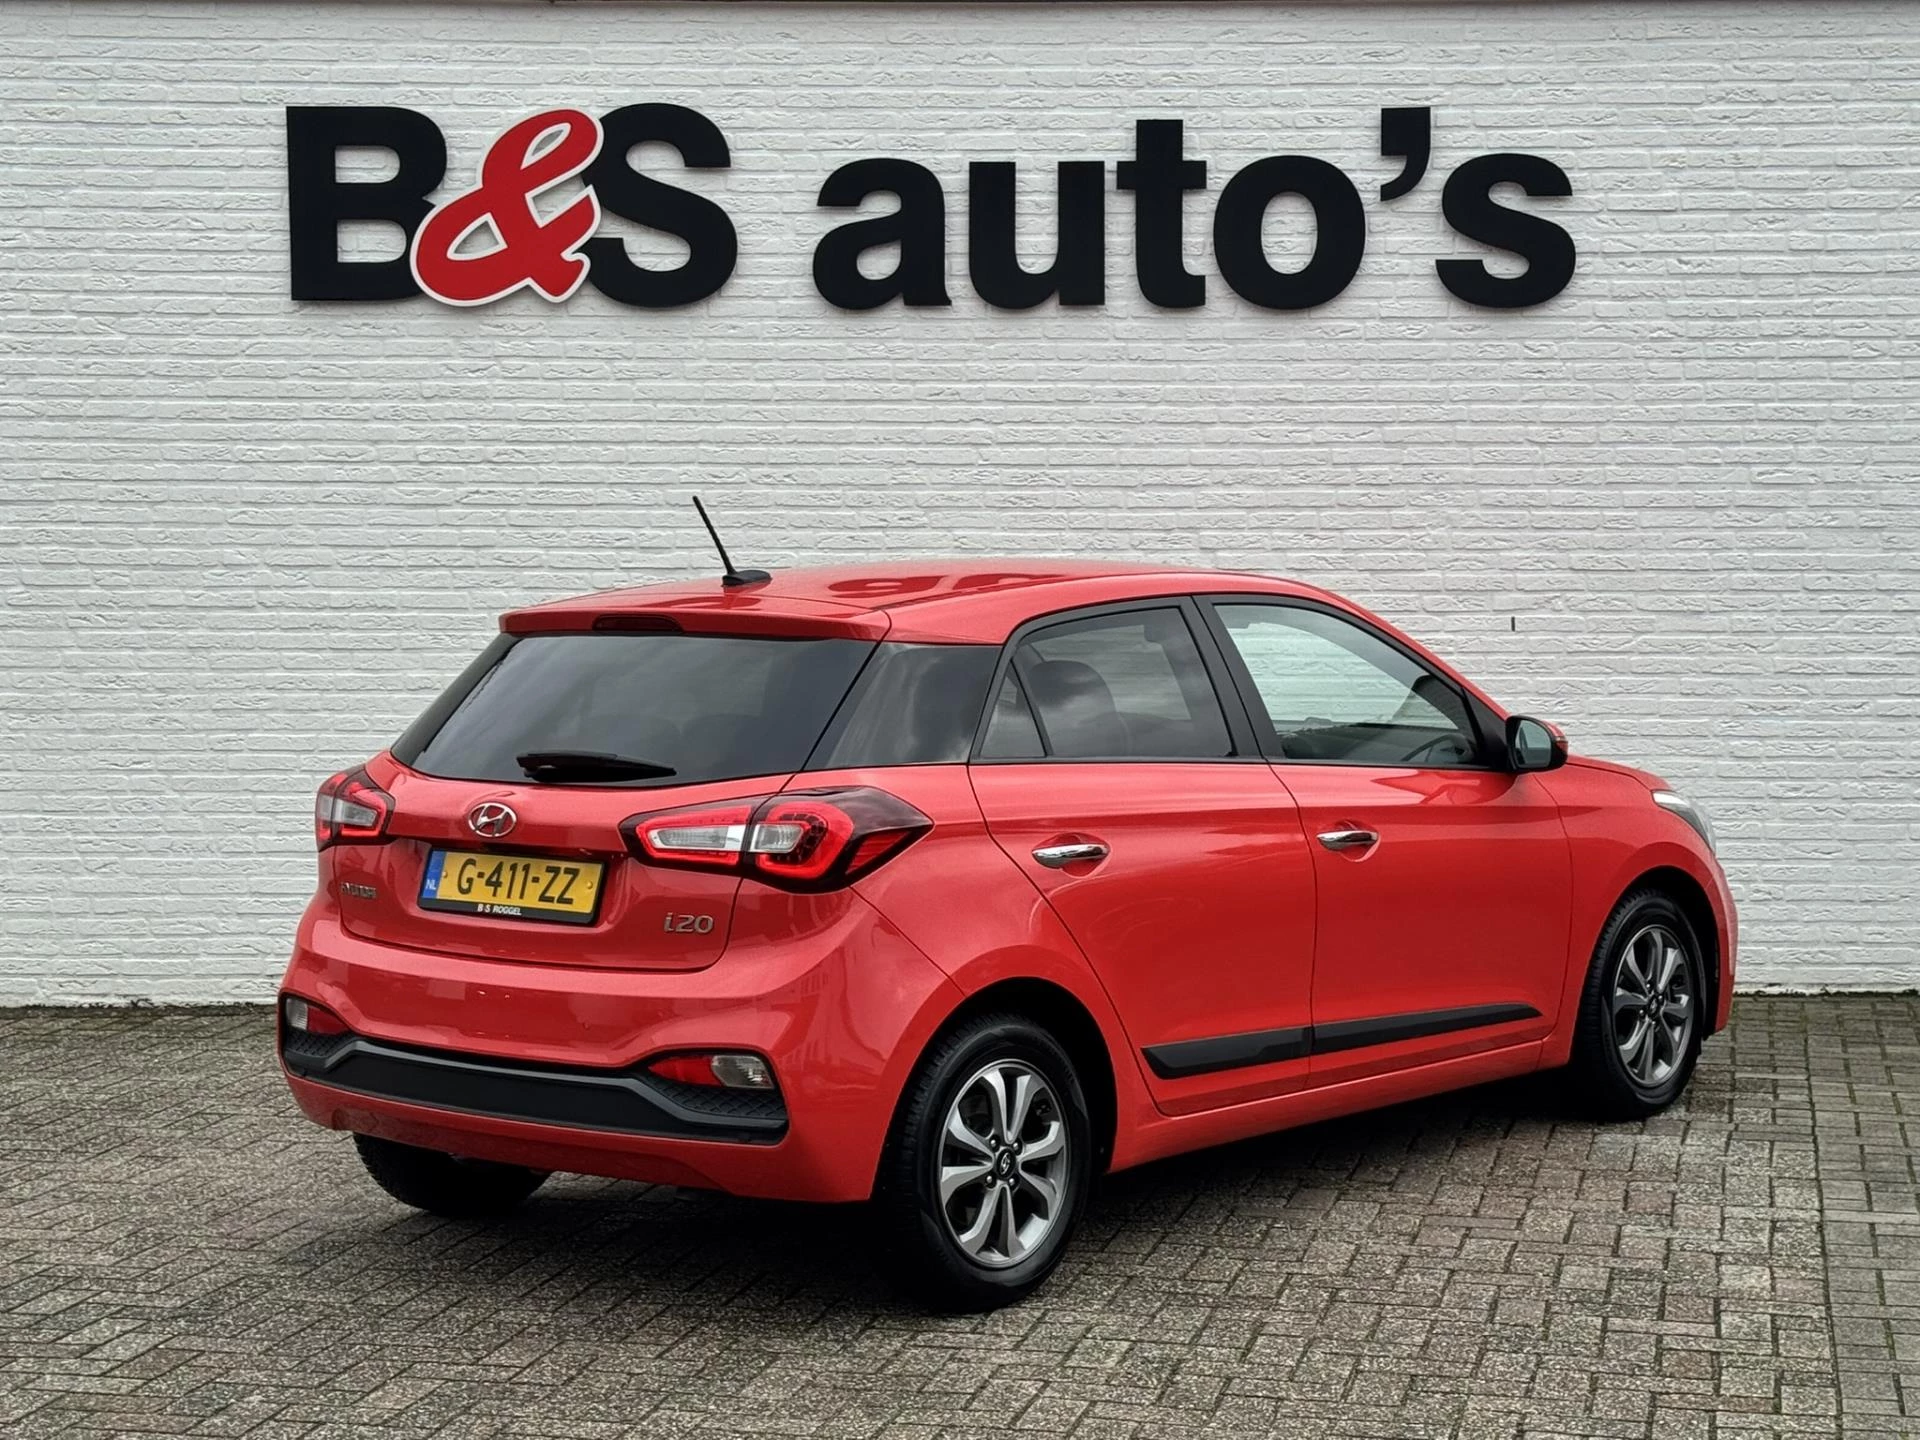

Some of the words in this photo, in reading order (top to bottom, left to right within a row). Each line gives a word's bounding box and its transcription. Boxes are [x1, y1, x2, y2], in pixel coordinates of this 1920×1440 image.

[286, 102, 738, 308] B&S
[812, 106, 1577, 310] auto's
[425, 879, 437, 891] NL
[457, 857, 581, 905] G-411-ZZ
[664, 912, 714, 933] i20
